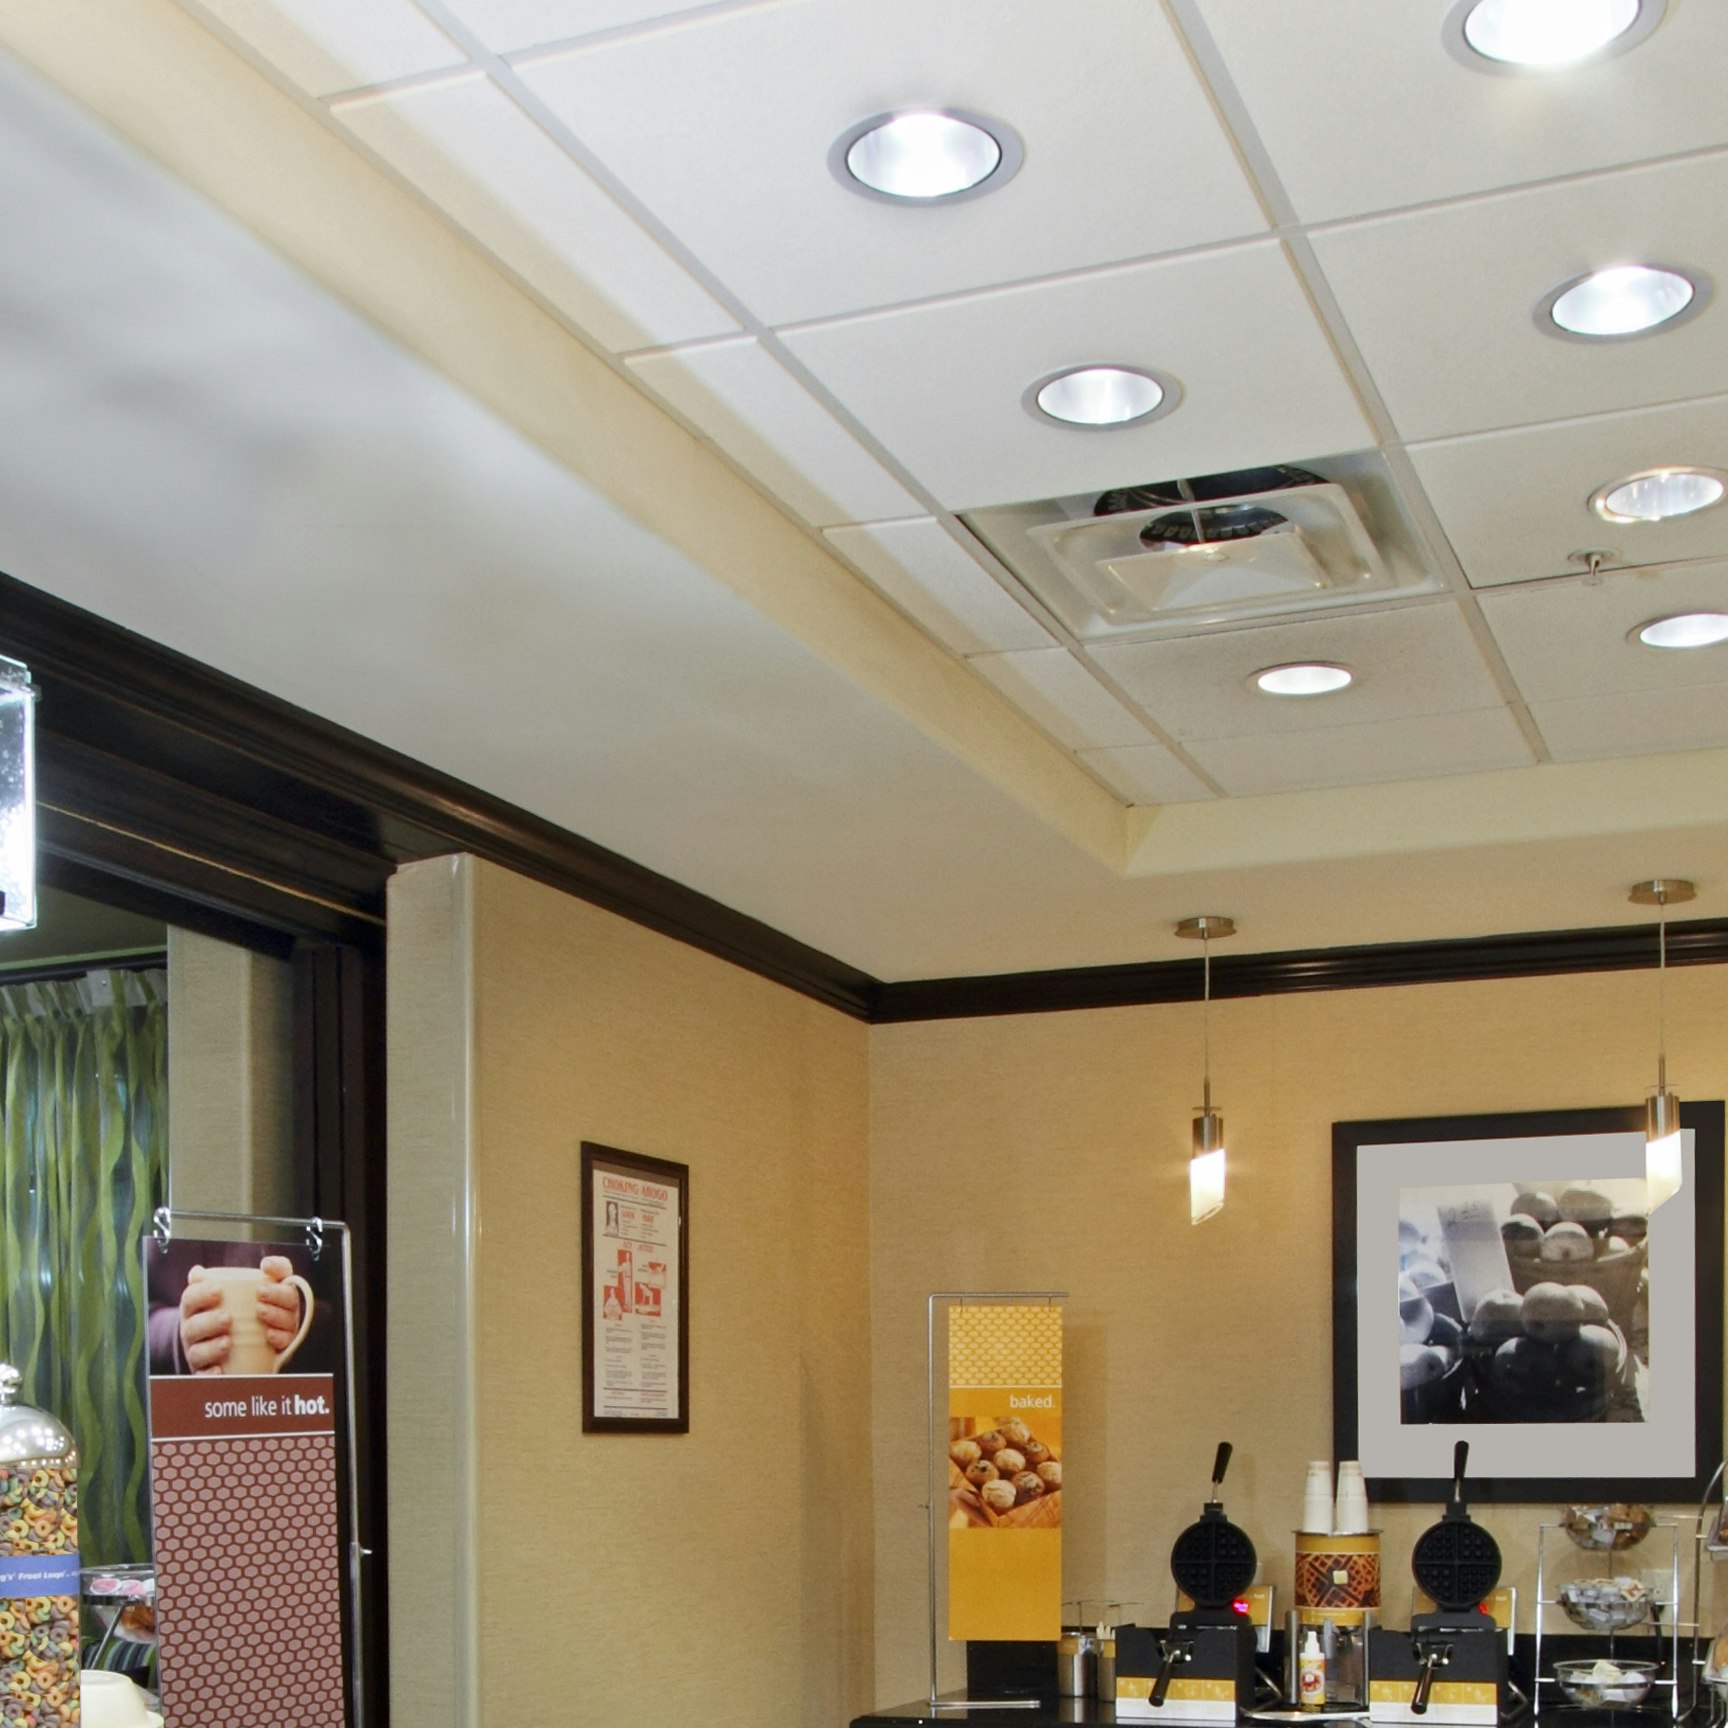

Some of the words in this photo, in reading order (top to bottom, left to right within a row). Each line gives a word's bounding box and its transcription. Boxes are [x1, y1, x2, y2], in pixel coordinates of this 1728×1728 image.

[204, 1401, 247, 1418] some
[251, 1395, 277, 1416] like
[281, 1395, 292, 1416] it
[294, 1394, 330, 1415] hot.
[1010, 1394, 1056, 1408] baked.
